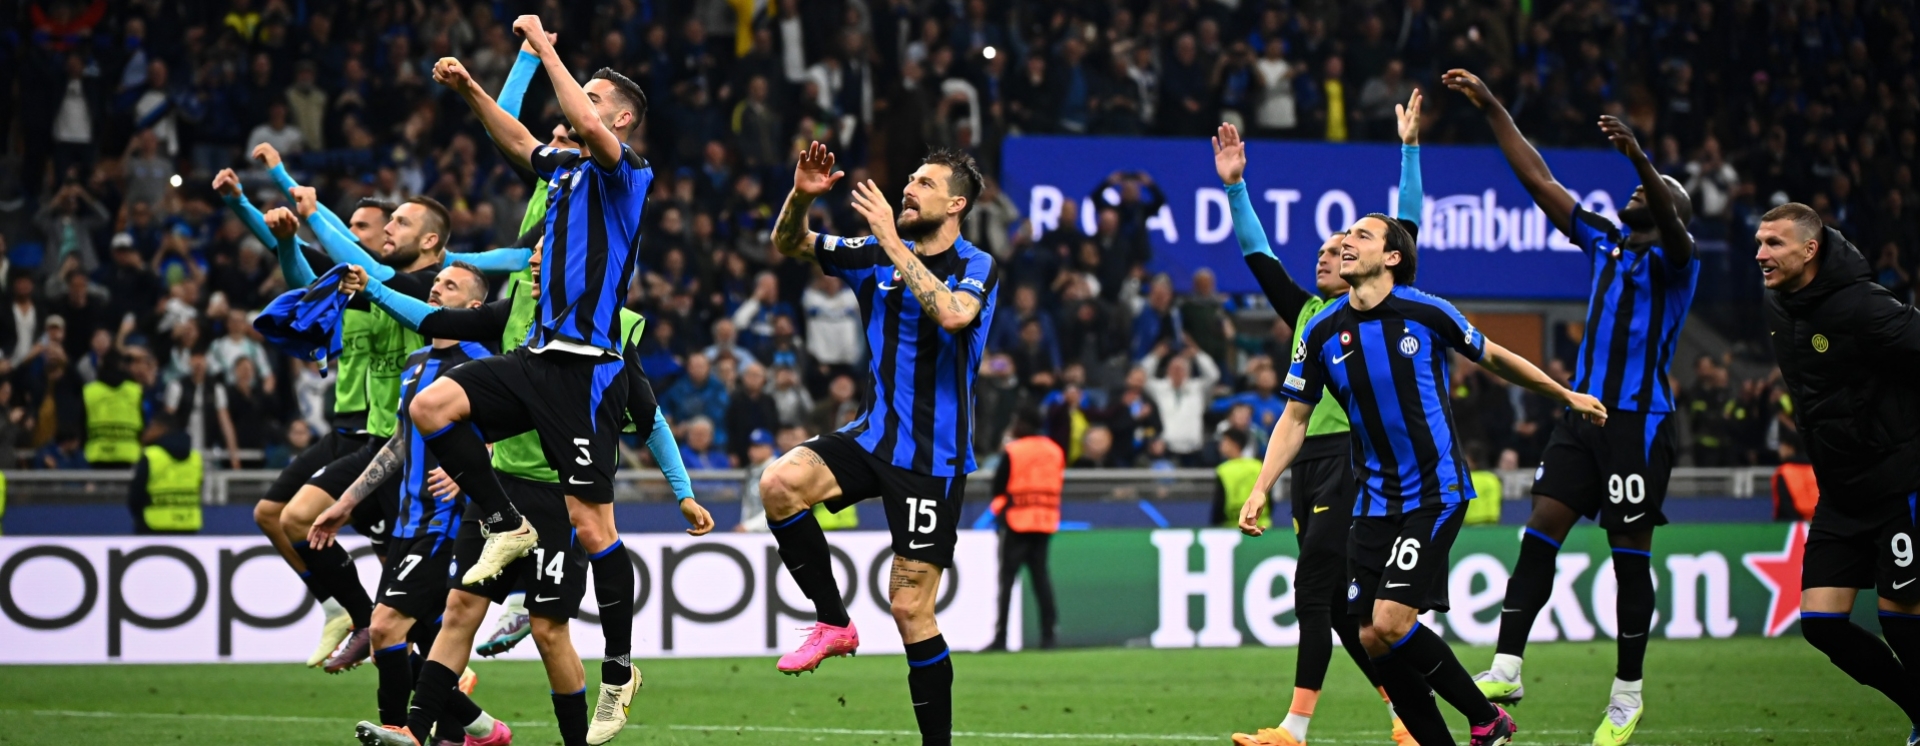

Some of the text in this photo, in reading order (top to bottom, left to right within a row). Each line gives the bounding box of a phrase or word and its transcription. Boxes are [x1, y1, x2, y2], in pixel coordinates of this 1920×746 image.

[573, 437, 593, 466] 5
[1608, 473, 1645, 504] 90
[905, 497, 937, 534] 15
[393, 554, 423, 581] 7
[533, 548, 565, 585] 14
[1891, 532, 1913, 567] 9
[0, 545, 378, 657] opp
[1151, 526, 1738, 648] Heekn
